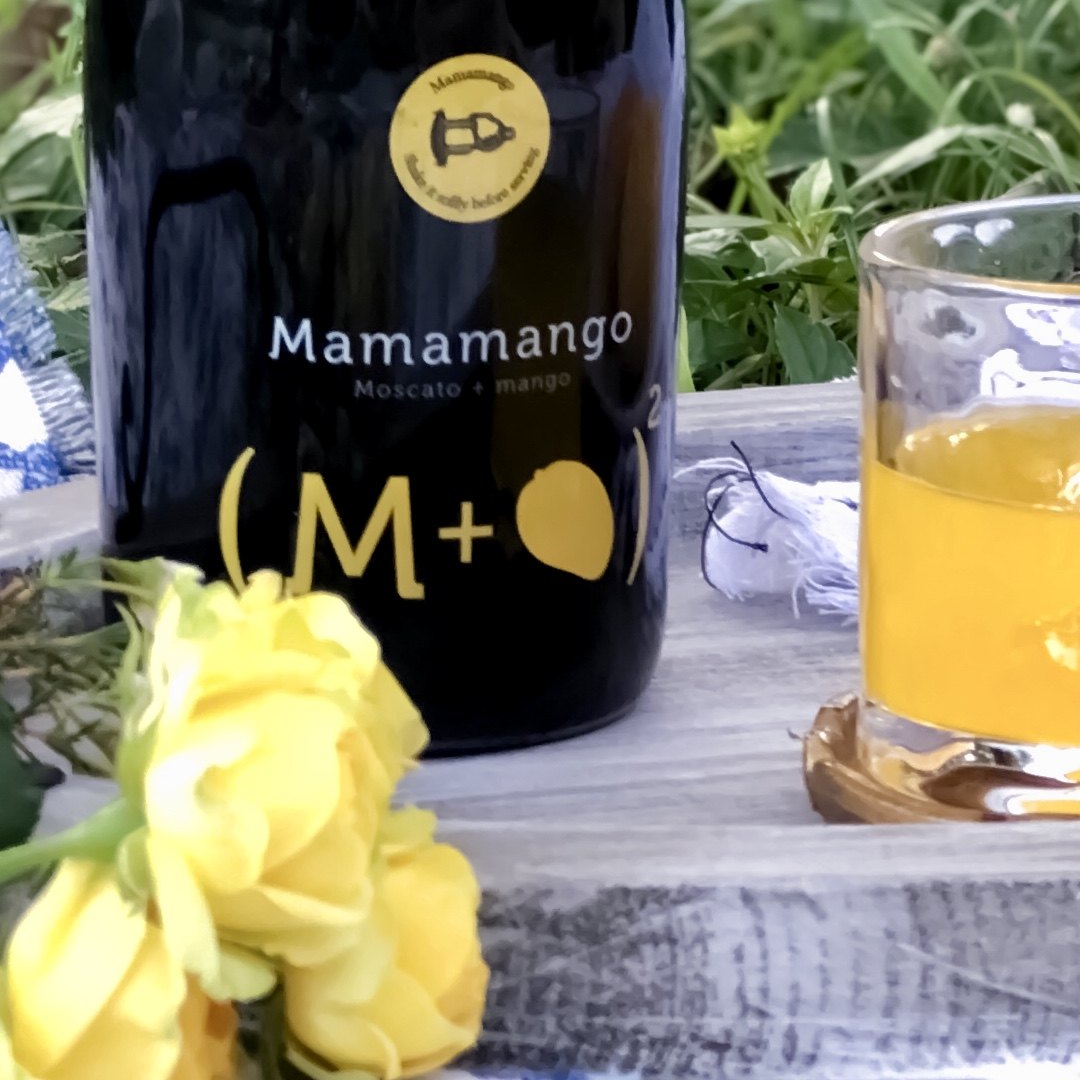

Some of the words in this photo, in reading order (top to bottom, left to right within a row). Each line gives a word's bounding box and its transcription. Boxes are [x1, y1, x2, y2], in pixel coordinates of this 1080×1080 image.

[268, 310, 634, 366] Mamamango
[353, 377, 462, 399] Moscato
[472, 382, 485, 395] +
[496, 371, 571, 396] mango
